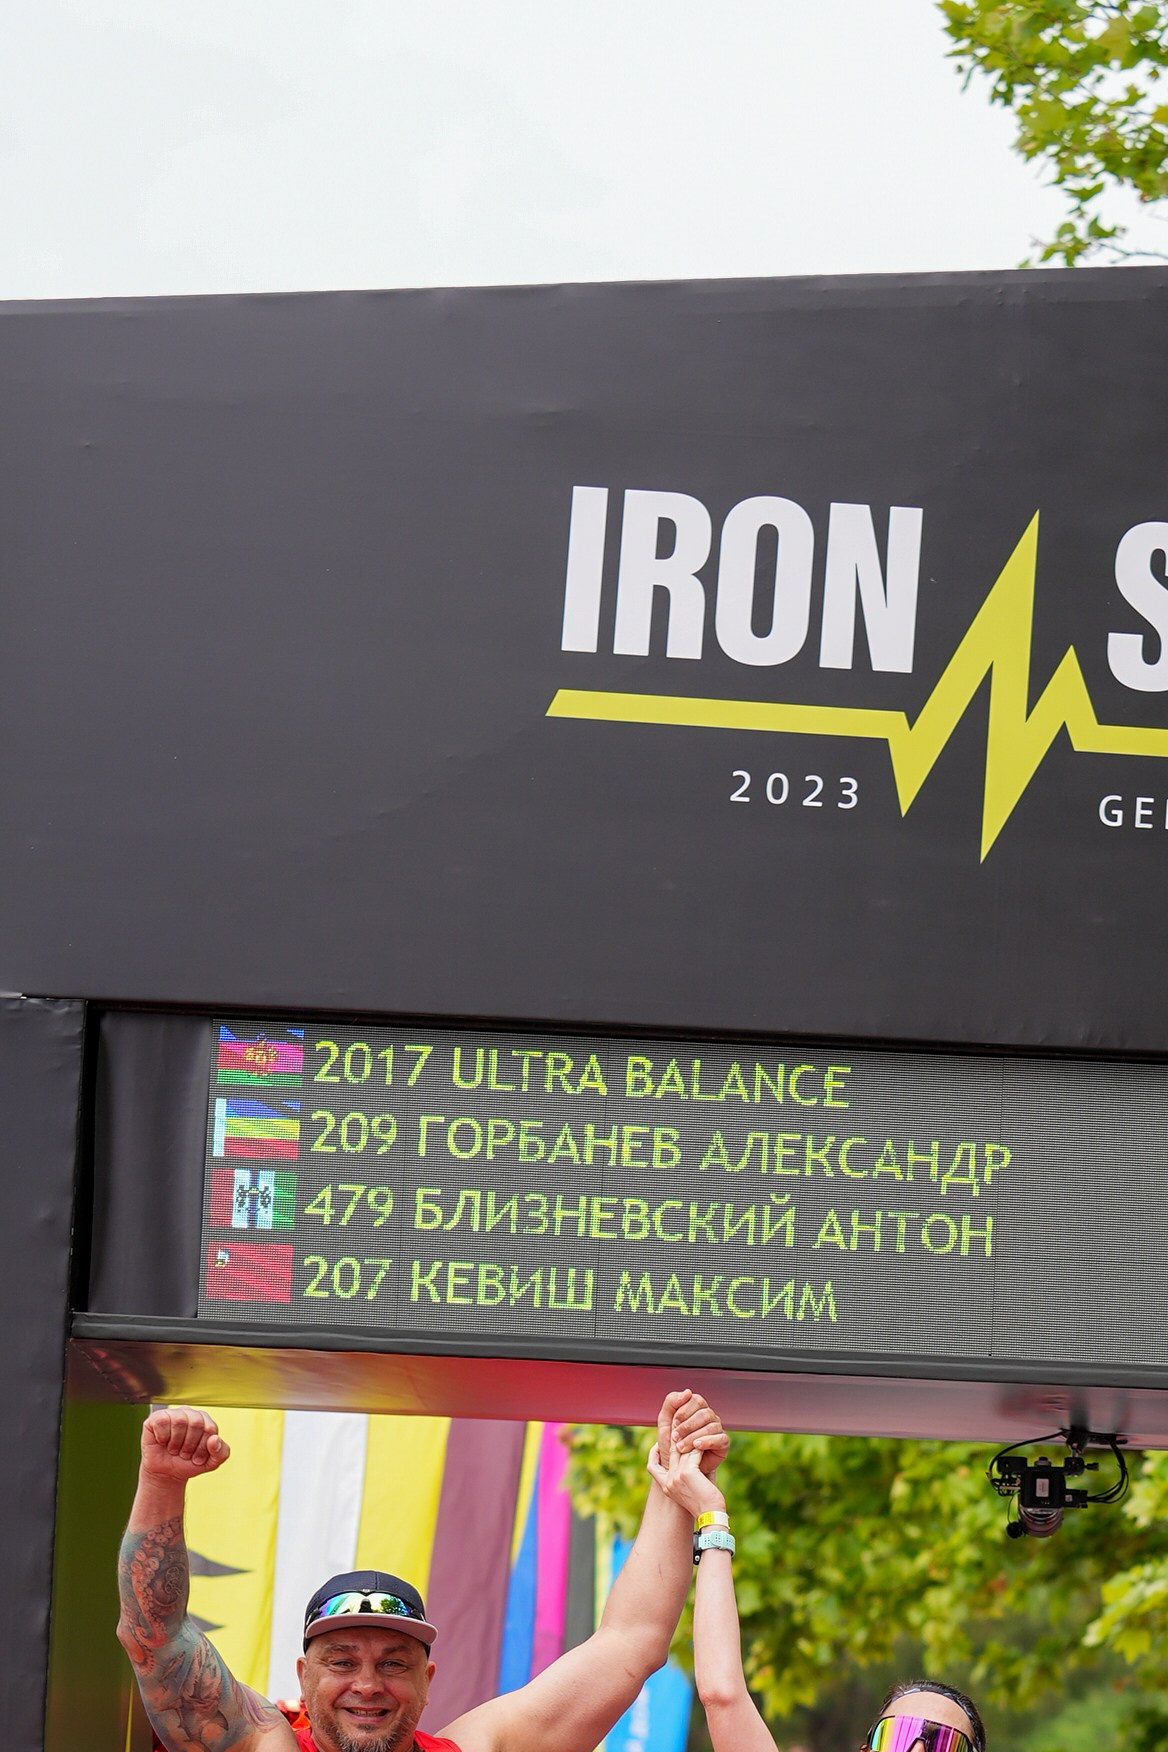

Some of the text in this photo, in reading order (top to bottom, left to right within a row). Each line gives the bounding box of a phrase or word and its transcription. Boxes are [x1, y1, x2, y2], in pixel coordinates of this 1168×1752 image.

[561, 485, 924, 673] IRON
[729, 770, 860, 809] 2023
[313, 1040, 433, 1087] 2017
[451, 1047, 608, 1096] ULTRA
[624, 1056, 852, 1108] BALANCE
[311, 1110, 397, 1154] 209
[417, 1115, 682, 1168] ГОРБАНЕВ
[700, 1132, 1012, 1198] АЛЕКСАНДР
[304, 1184, 394, 1226] 479
[414, 1189, 796, 1246] БЛИЗНЕВСКИЙ
[813, 1211, 994, 1256] АНТОН
[303, 1256, 391, 1300] 207
[410, 1260, 595, 1311] КЕВИШ
[615, 1270, 838, 1322] МАКСИМ
